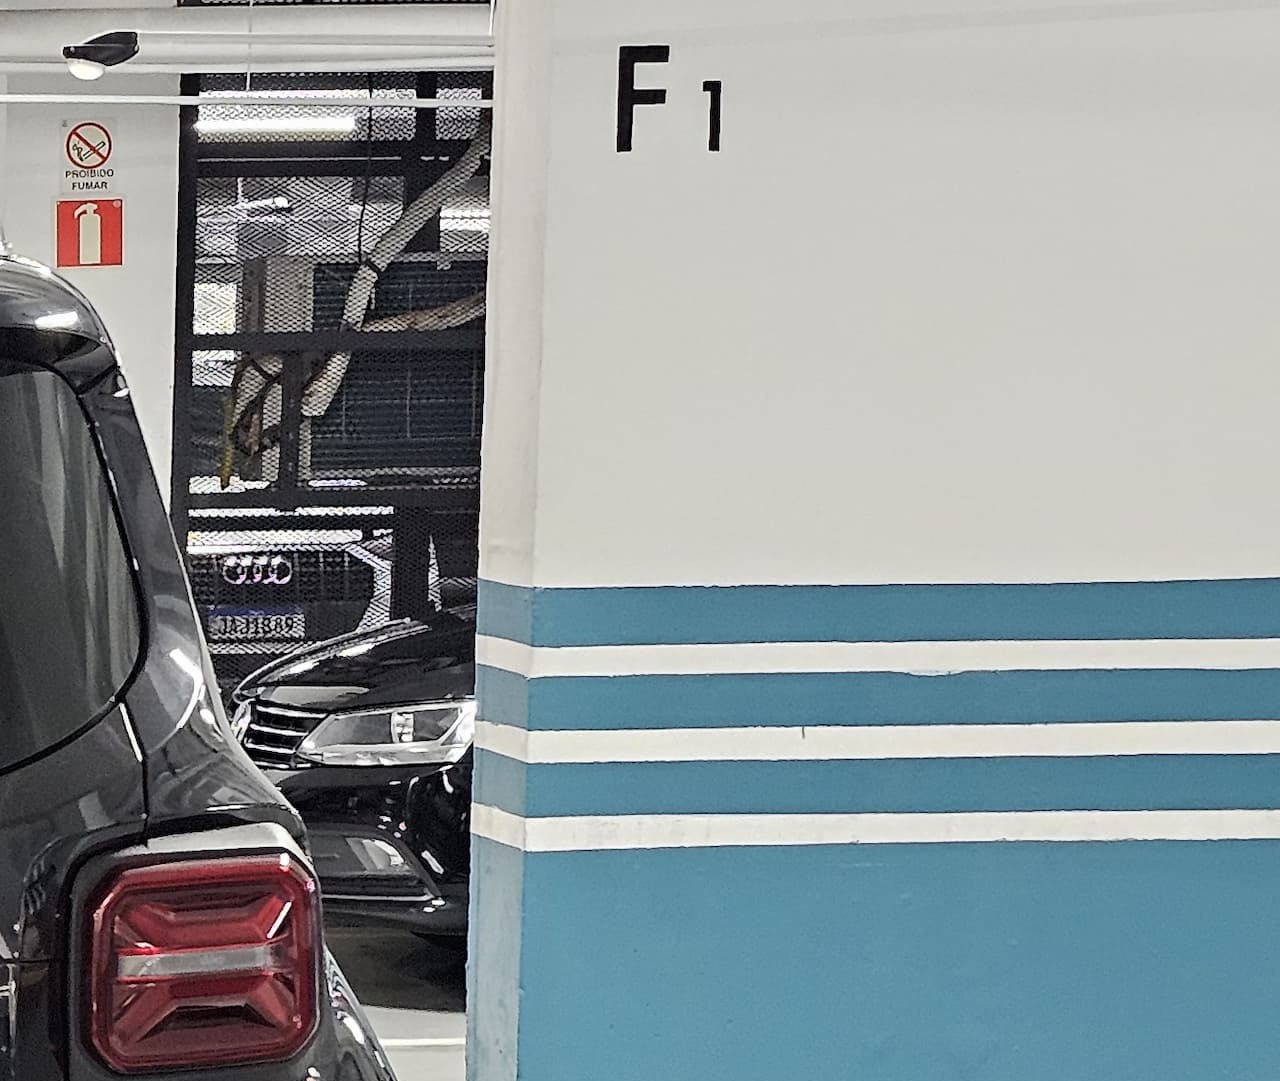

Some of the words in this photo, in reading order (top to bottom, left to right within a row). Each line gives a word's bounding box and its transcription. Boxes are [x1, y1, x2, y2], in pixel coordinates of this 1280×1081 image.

[615, 45, 670, 153] F
[702, 80, 722, 152] 1
[65, 168, 114, 179] PROIBIDO
[72, 180, 108, 190] FUMAR
